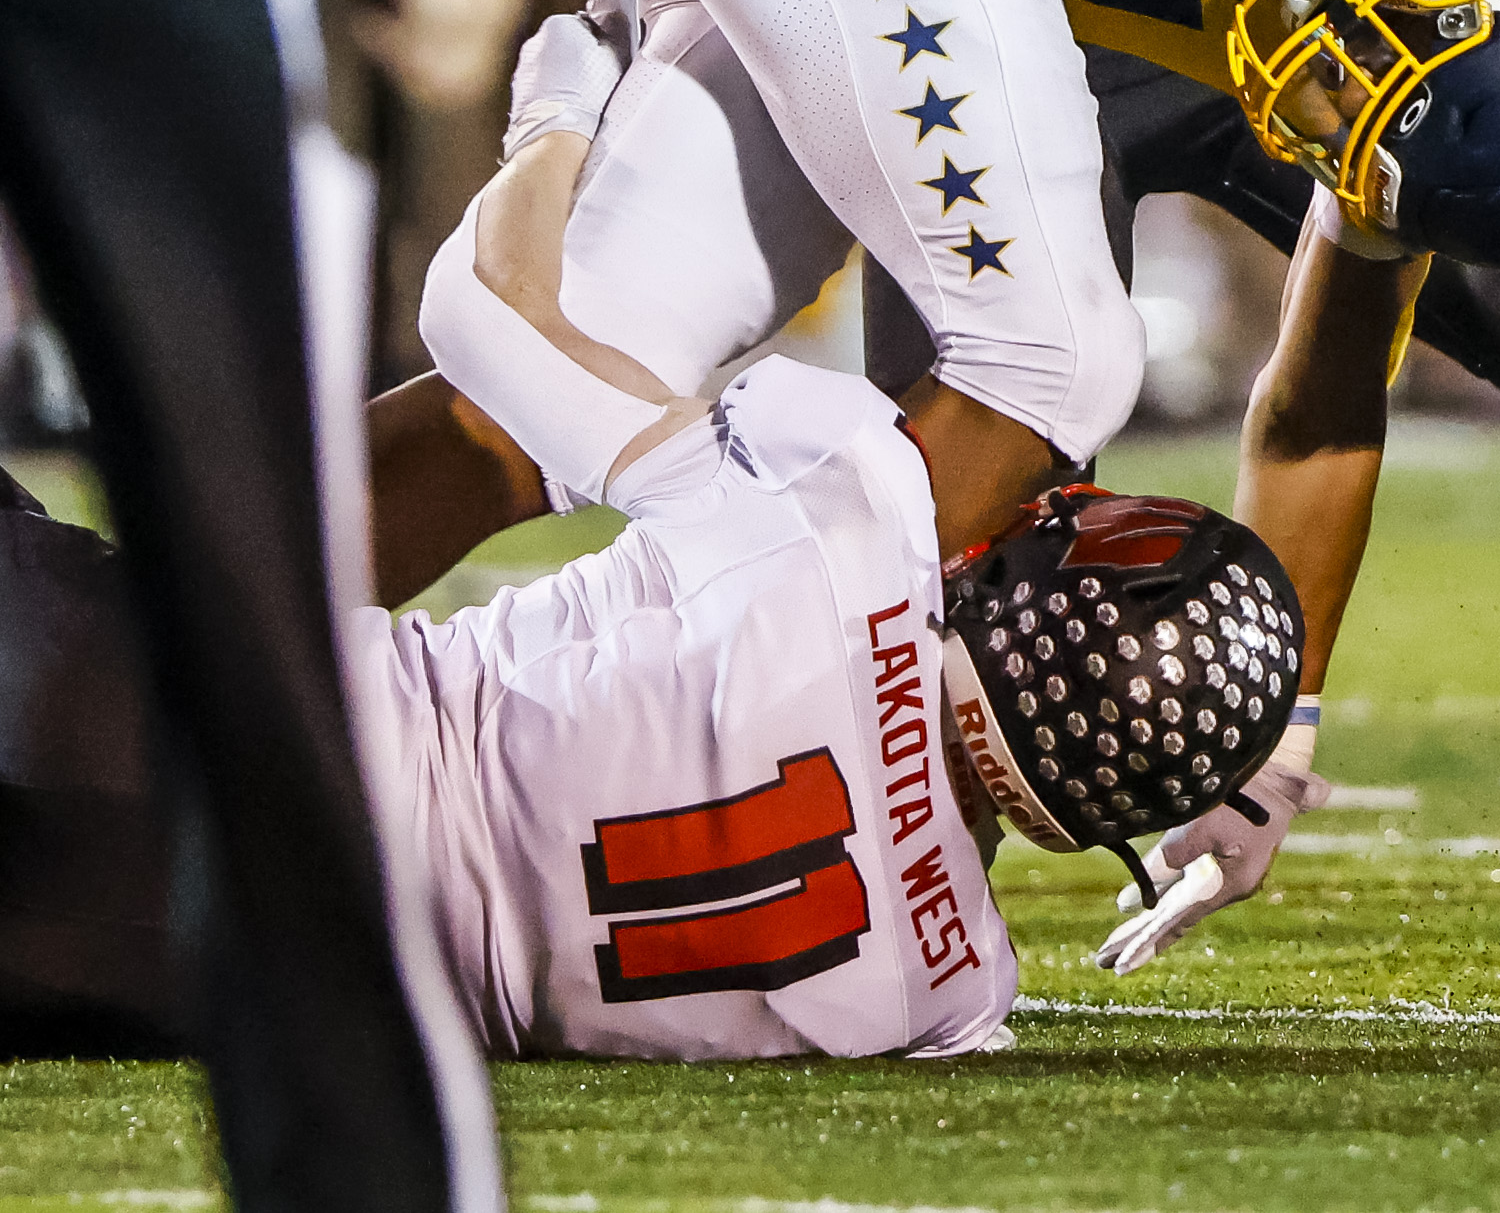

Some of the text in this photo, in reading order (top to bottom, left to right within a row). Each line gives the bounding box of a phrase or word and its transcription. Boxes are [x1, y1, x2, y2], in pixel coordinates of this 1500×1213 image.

[580, 745, 872, 1004] 11
[866, 598, 934, 847] LAKOTA
[900, 843, 981, 991] WEST
[955, 697, 1059, 842] Riddell
